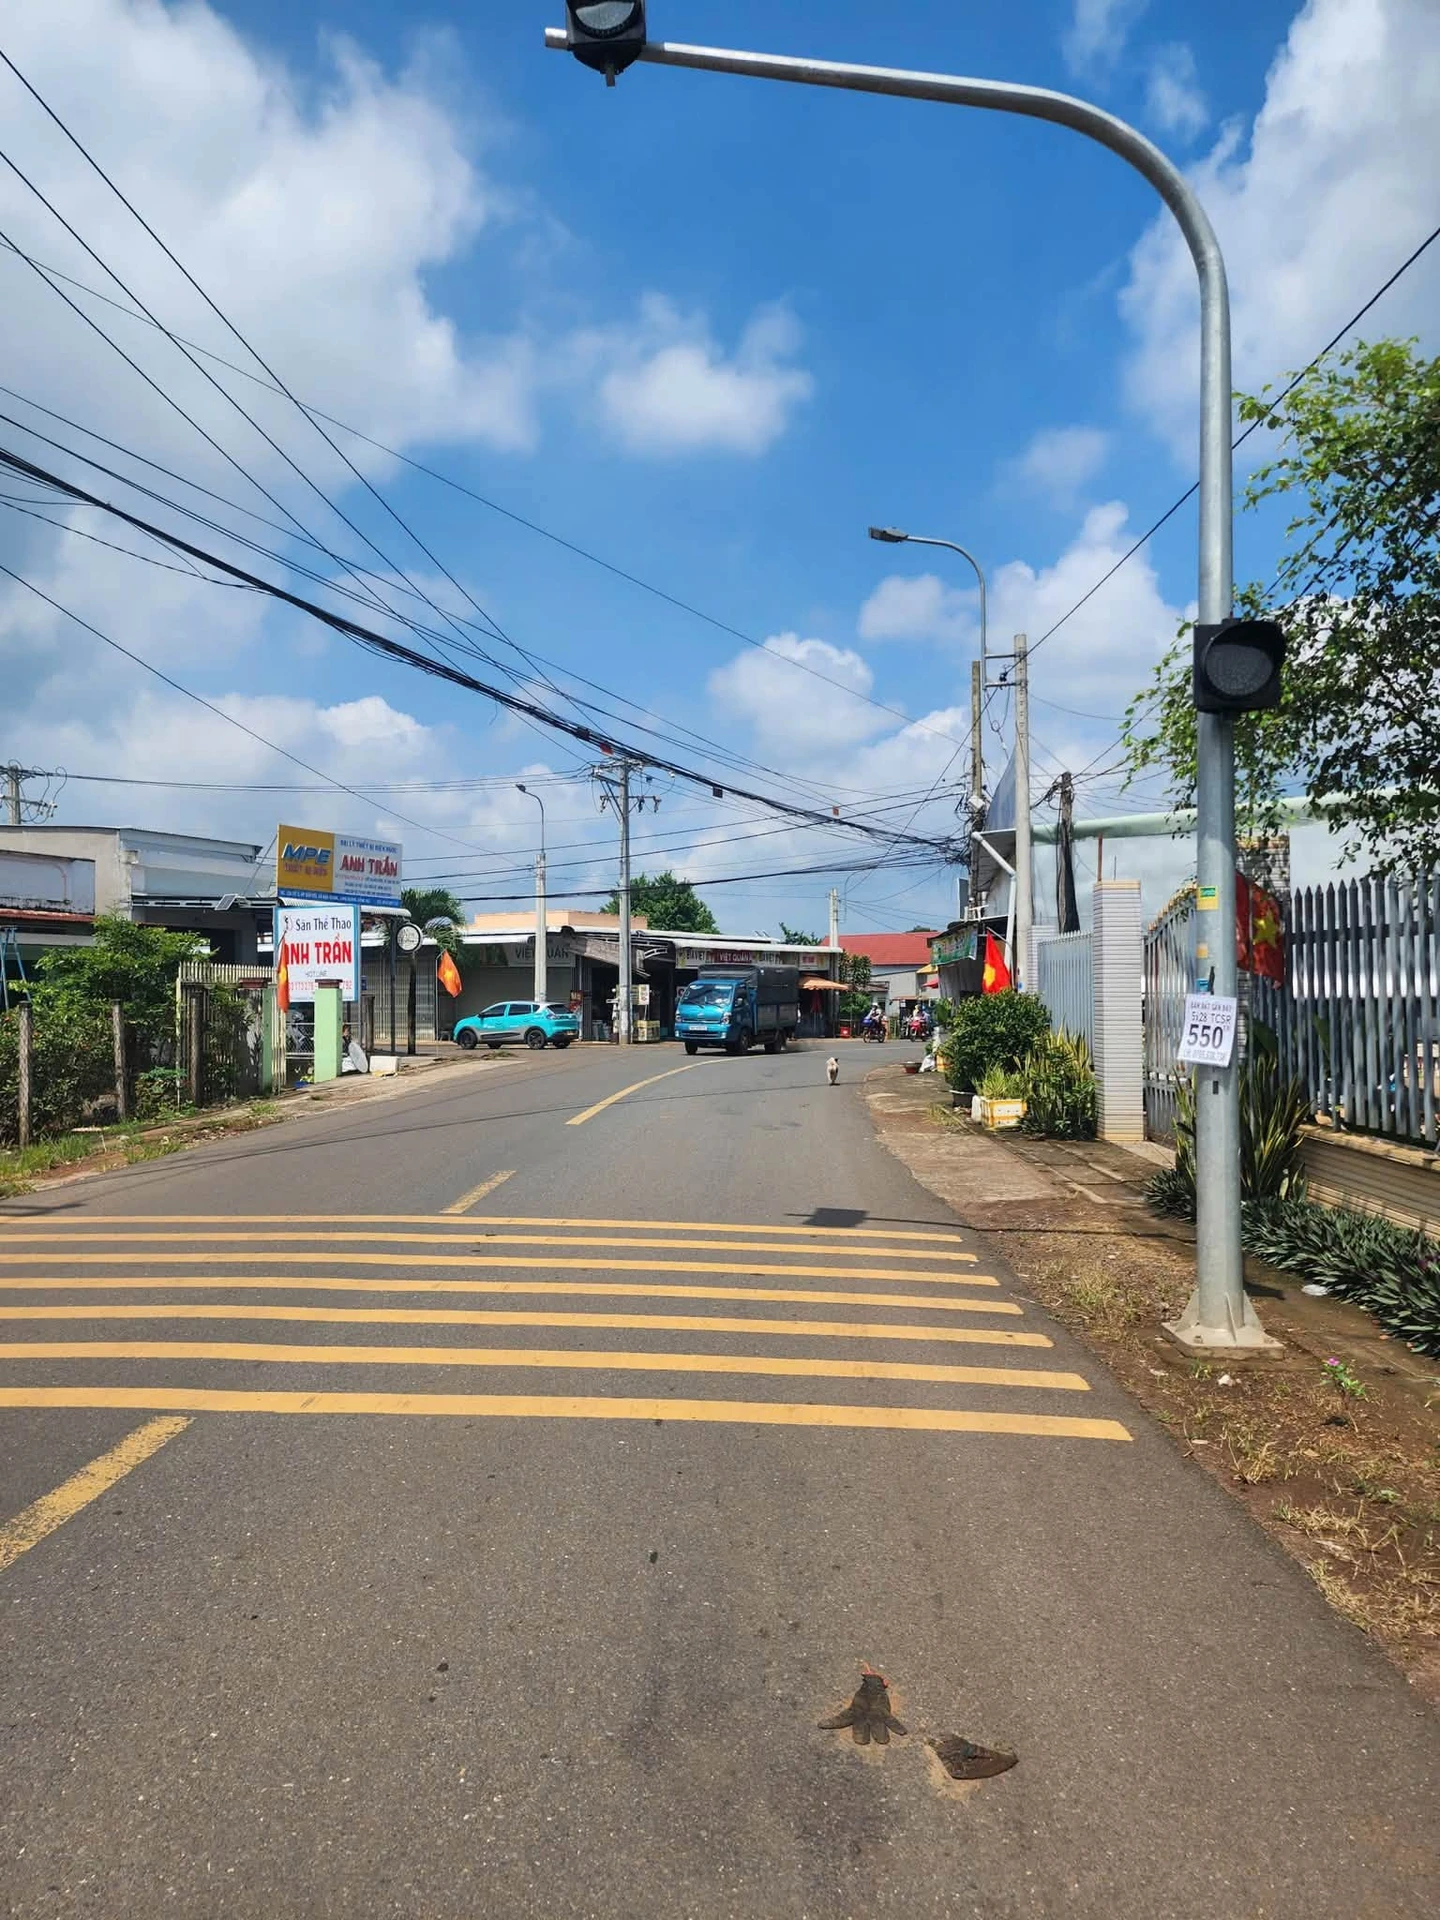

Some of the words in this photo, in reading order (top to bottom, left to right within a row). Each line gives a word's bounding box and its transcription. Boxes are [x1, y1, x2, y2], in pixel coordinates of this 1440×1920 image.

[281, 842, 331, 865] MPE
[340, 854, 365, 872] ANH
[330, 917, 352, 930] Thao
[546, 944, 569, 959] UÁN
[1187, 1023, 1223, 1049] 550
